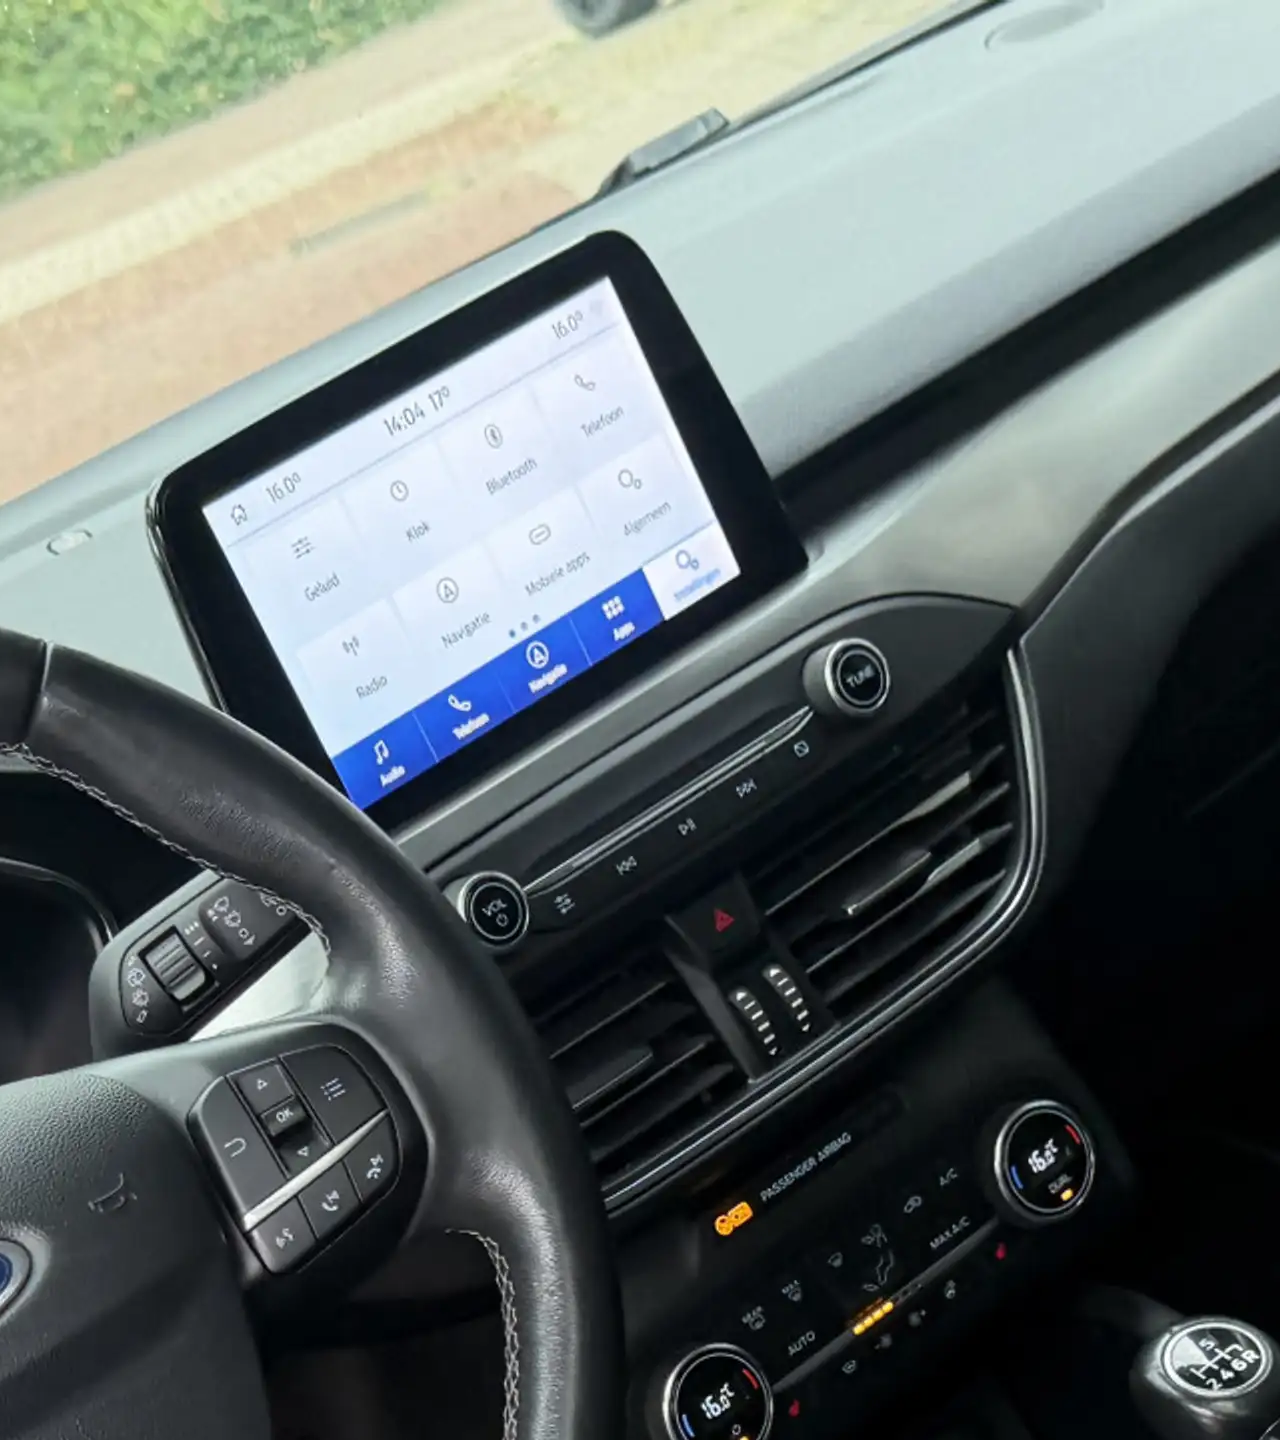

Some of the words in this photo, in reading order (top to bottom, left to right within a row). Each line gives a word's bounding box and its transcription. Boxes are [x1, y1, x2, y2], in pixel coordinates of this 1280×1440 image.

[383, 402, 426, 436] 14:04
[580, 406, 624, 438] Telefoon
[485, 457, 538, 495] Bluetooth
[406, 519, 431, 542] Klok
[623, 502, 672, 537] Algemeen
[304, 572, 341, 601] Geluid
[525, 565, 565, 597] Mobiele
[566, 552, 590, 575] apps
[441, 612, 490, 649] Navigatie
[356, 675, 388, 700] Radio
[846, 664, 875, 687] TUNE
[481, 898, 508, 917] VOL
[275, 1107, 294, 1123] OK
[760, 1156, 818, 1202] PASSENGER
[818, 1132, 851, 1162] AIRBAG
[939, 1167, 958, 1186] A/C
[1048, 1174, 1073, 1194] DUAL
[929, 1229, 953, 1249] MAX
[952, 1216, 970, 1233] A/C
[788, 1330, 816, 1356] AUTO
[1199, 1338, 1215, 1351] 5
[1205, 1378, 1223, 1391] 2
[1220, 1369, 1235, 1380] 4
[1231, 1359, 1247, 1371] 6
[1240, 1350, 1260, 1363] R
